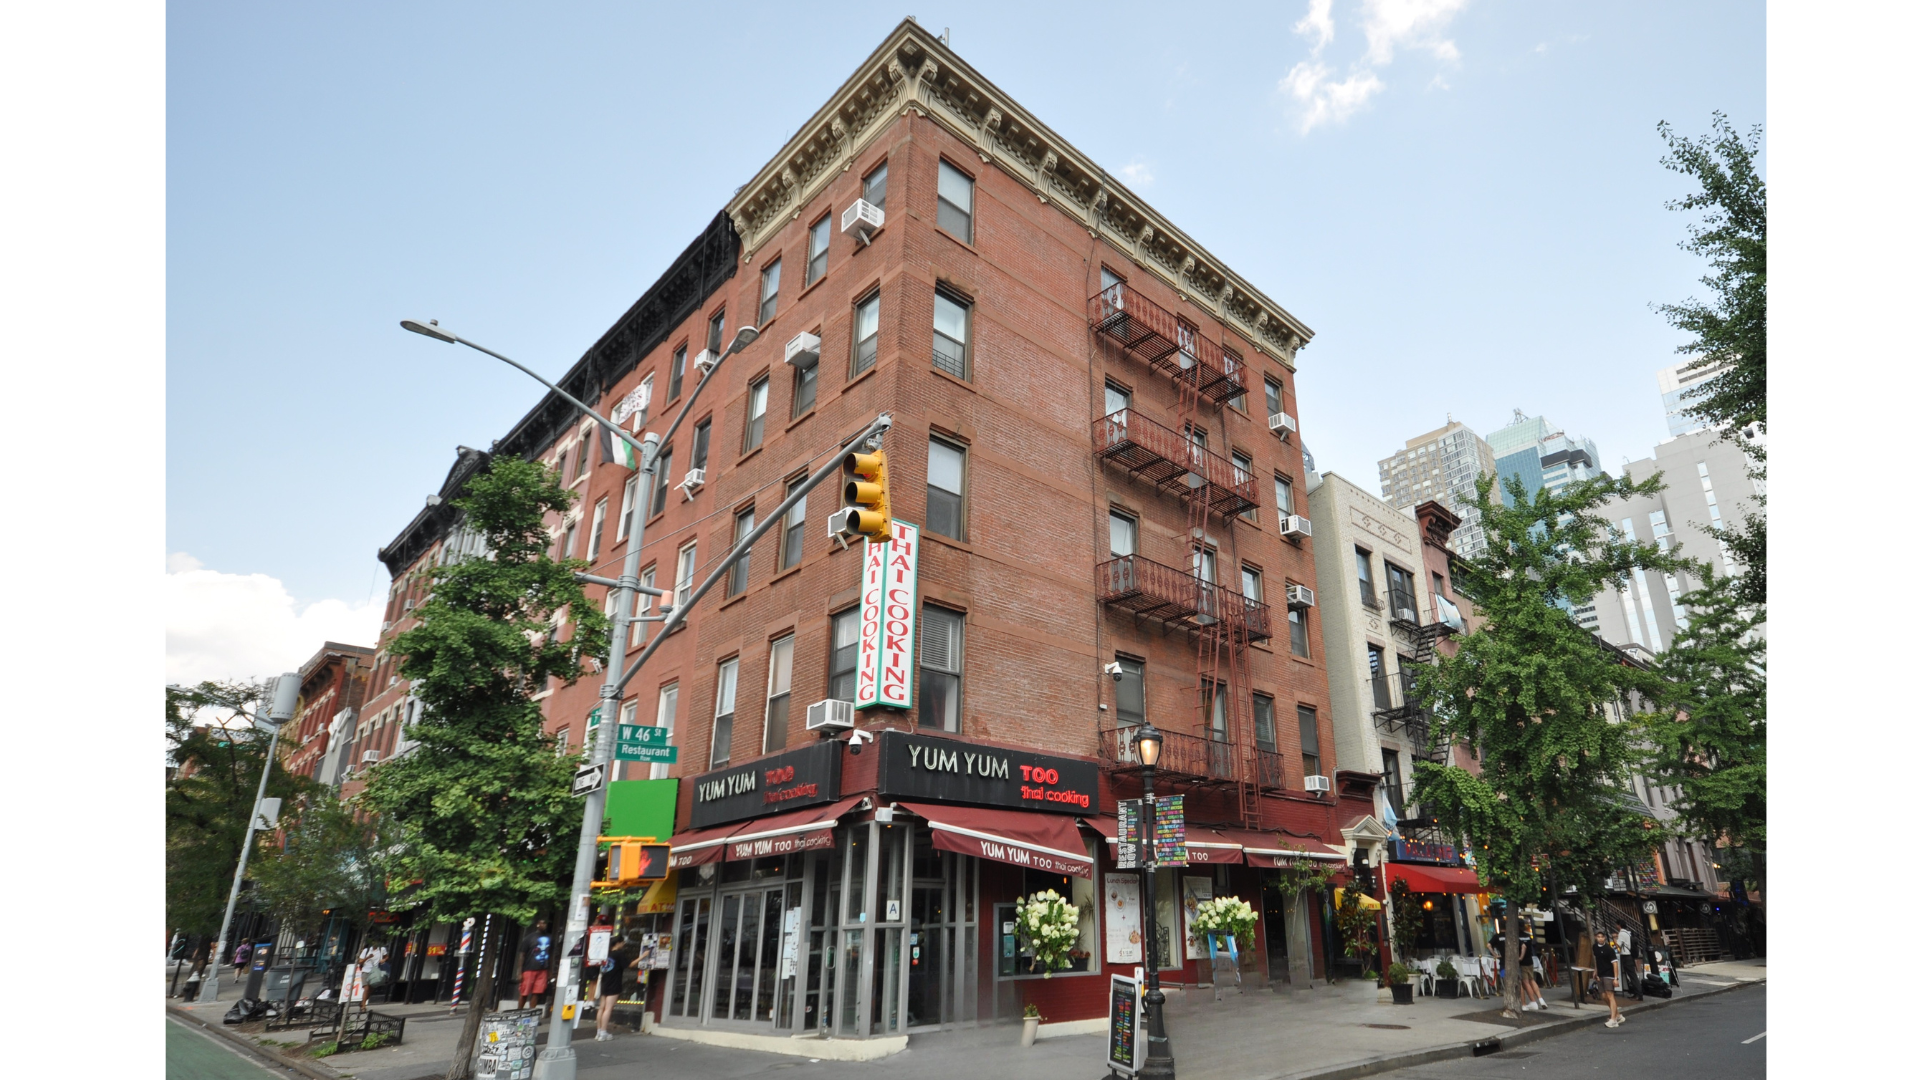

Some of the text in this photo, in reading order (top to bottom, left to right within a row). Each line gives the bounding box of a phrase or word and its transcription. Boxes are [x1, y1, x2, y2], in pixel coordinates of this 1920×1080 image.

[858, 541, 882, 701] HAI COOKING
[883, 522, 912, 701] THAI COOKING
[622, 726, 662, 742] W 46 St
[621, 744, 670, 757] Restaurant
[907, 744, 1009, 780] YUM YUM
[764, 765, 795, 786] TOO
[1019, 765, 1059, 784] TOO
[698, 770, 756, 802] YUM YUM
[1045, 790, 1090, 808] cooking
[1117, 801, 1128, 869] RESTAURANT
[735, 843, 753, 857] YUM
[754, 840, 773, 855] YUM
[775, 840, 792, 852] TOO
[806, 835, 831, 847] cooking
[1126, 843, 1137, 869] ROW
[1191, 851, 1209, 861] TOO
[678, 855, 692, 866] TOO
[980, 840, 1089, 877] YUM YUM TOO thai cooking
[1121, 877, 1138, 885] Special
[889, 903, 897, 914] A
